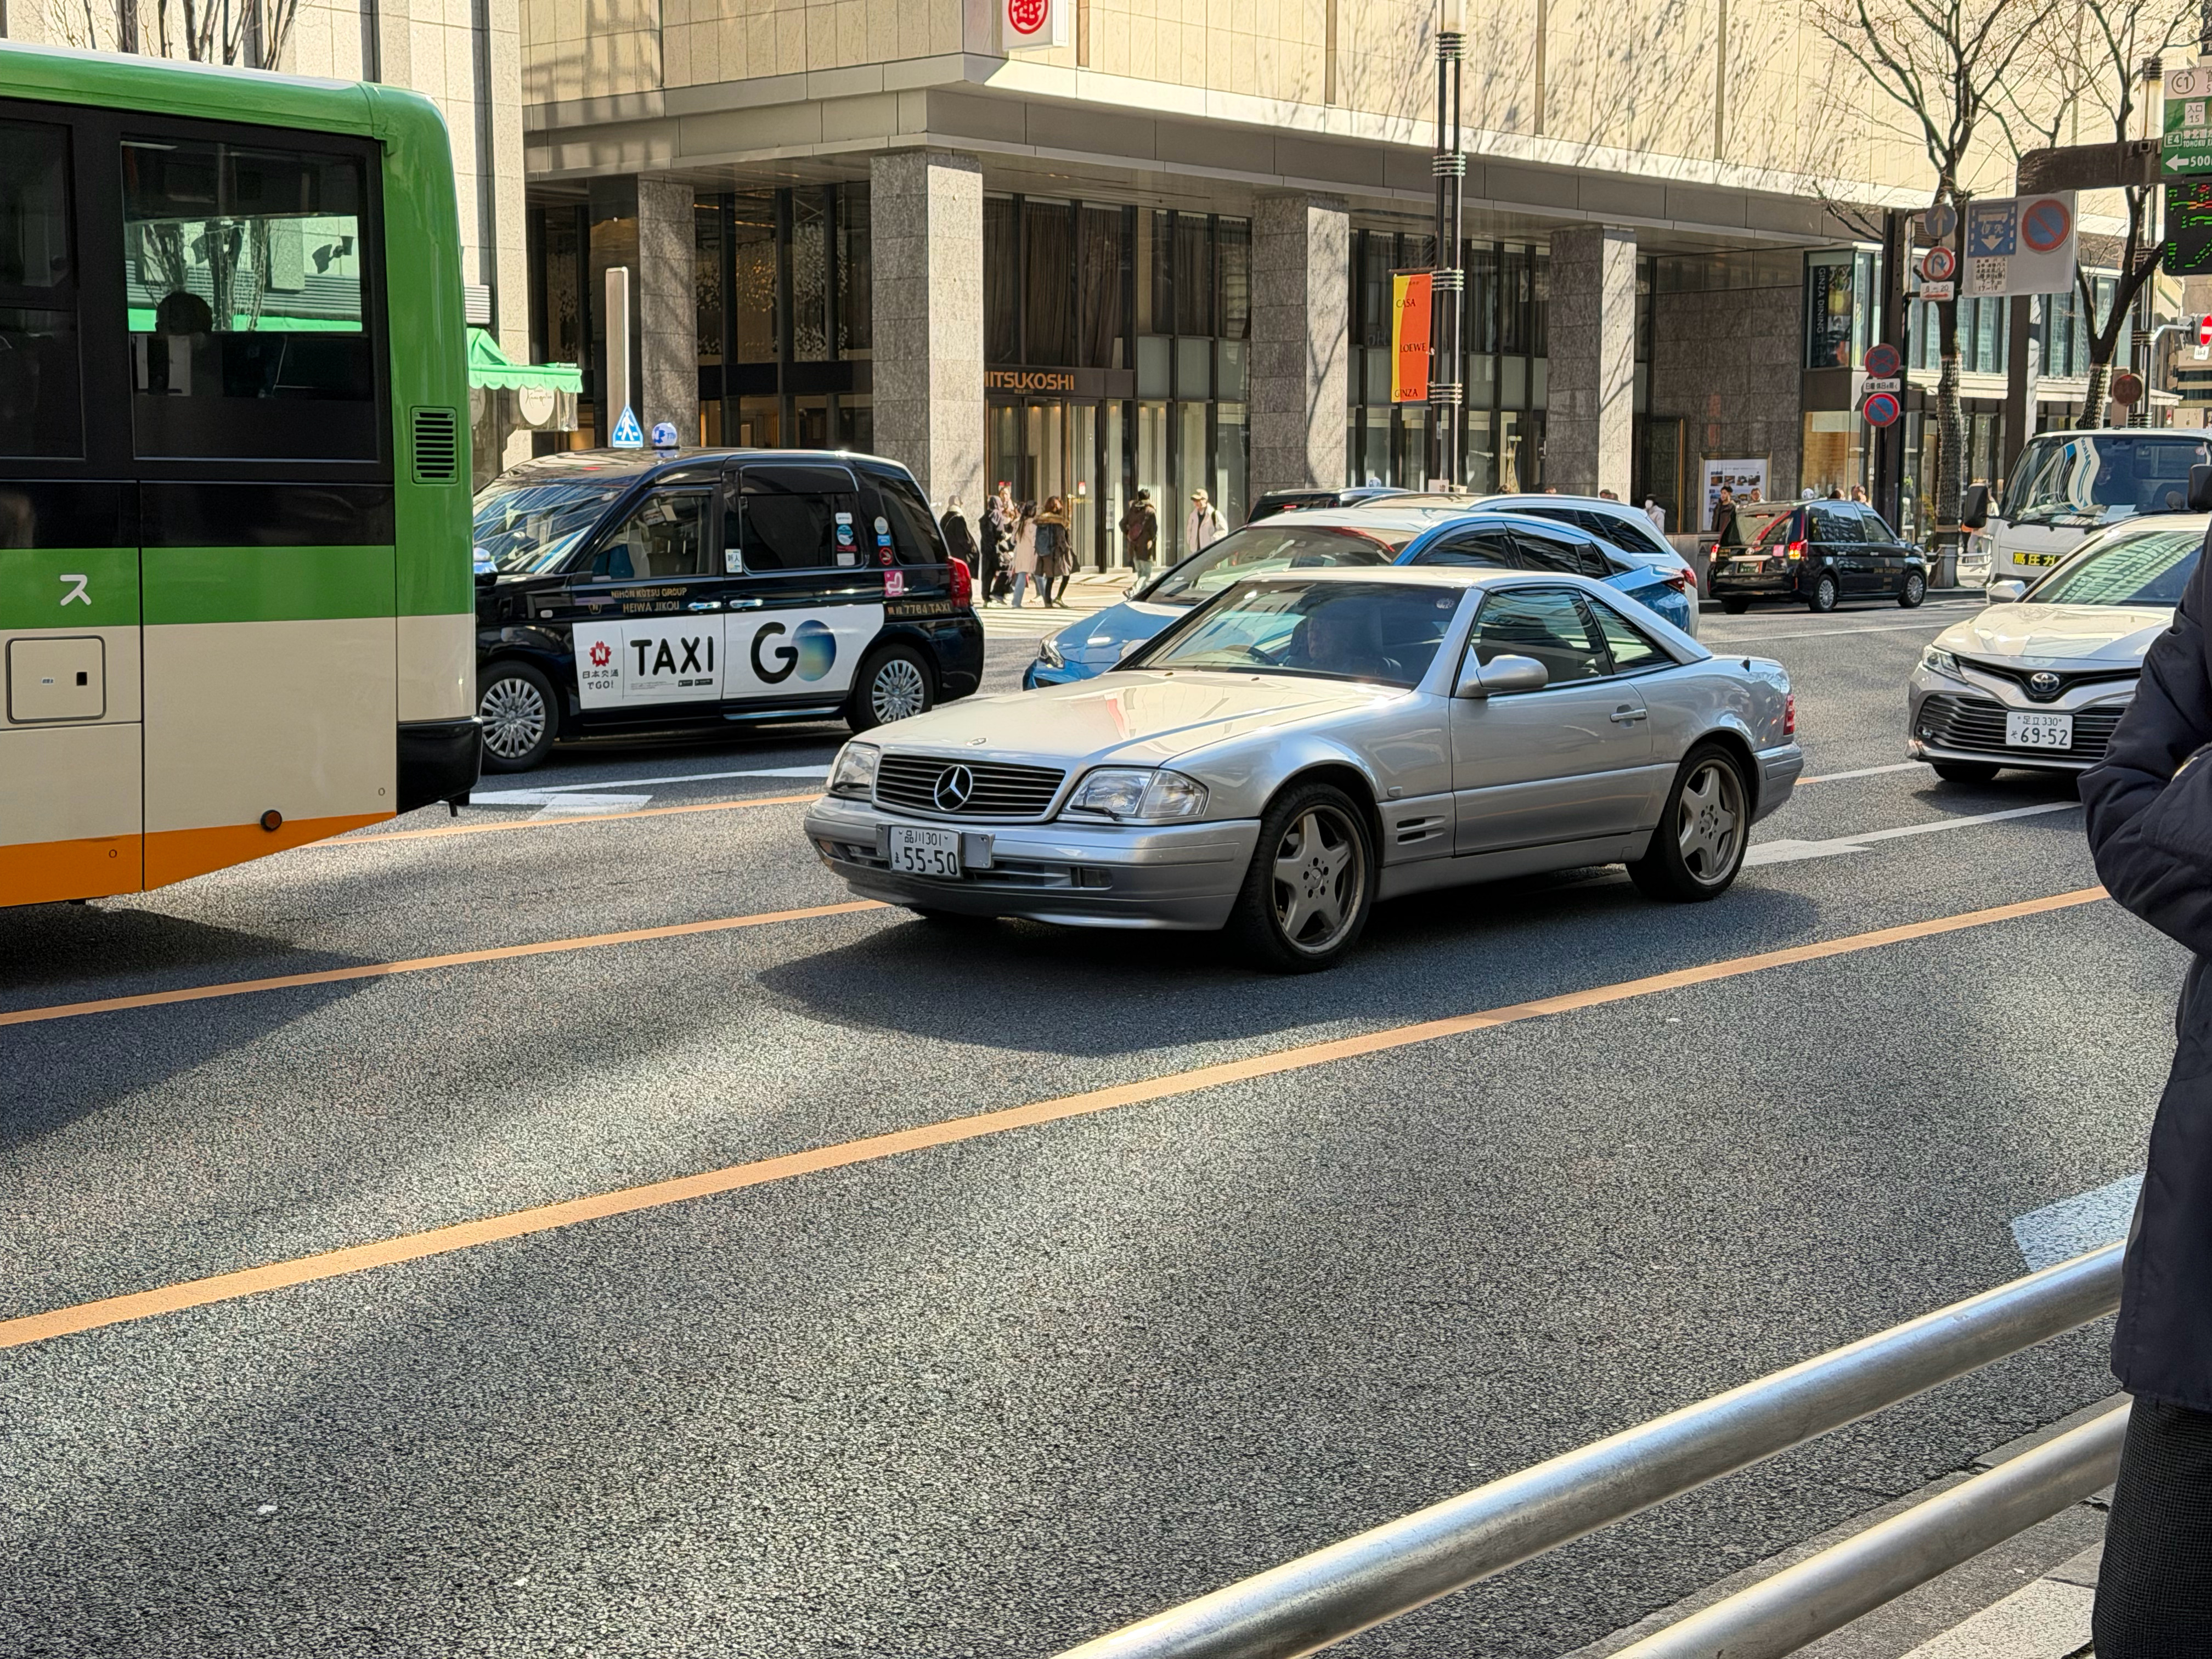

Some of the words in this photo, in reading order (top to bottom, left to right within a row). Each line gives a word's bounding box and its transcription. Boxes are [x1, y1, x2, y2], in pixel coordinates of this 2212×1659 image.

[2176, 76, 2189, 89] C1
[2187, 105, 2203, 113] 入口
[2190, 115, 2200, 123] 15
[2167, 135, 2180, 144] E4
[2183, 139, 2205, 148] TOHOKU
[2190, 155, 2212, 167] 500
[1396, 298, 1416, 308] CASA
[1816, 300, 1825, 334] DINING
[1400, 342, 1426, 353] LOEWE
[1394, 388, 1418, 398] GINZA
[2014, 553, 2062, 566] 高圧ガ
[60, 574, 92, 606] ス
[636, 588, 660, 597] KOTSU
[661, 587, 687, 597] GROUP
[623, 602, 652, 613] HEIWA
[654, 600, 680, 611] JIKOU
[929, 602, 952, 614] TAXI
[630, 636, 713, 676] TAXI
[751, 619, 837, 684] GO
[583, 669, 619, 679] 日本交通
[2021, 727, 2068, 746] 69-52
[904, 847, 957, 876] 55-50
